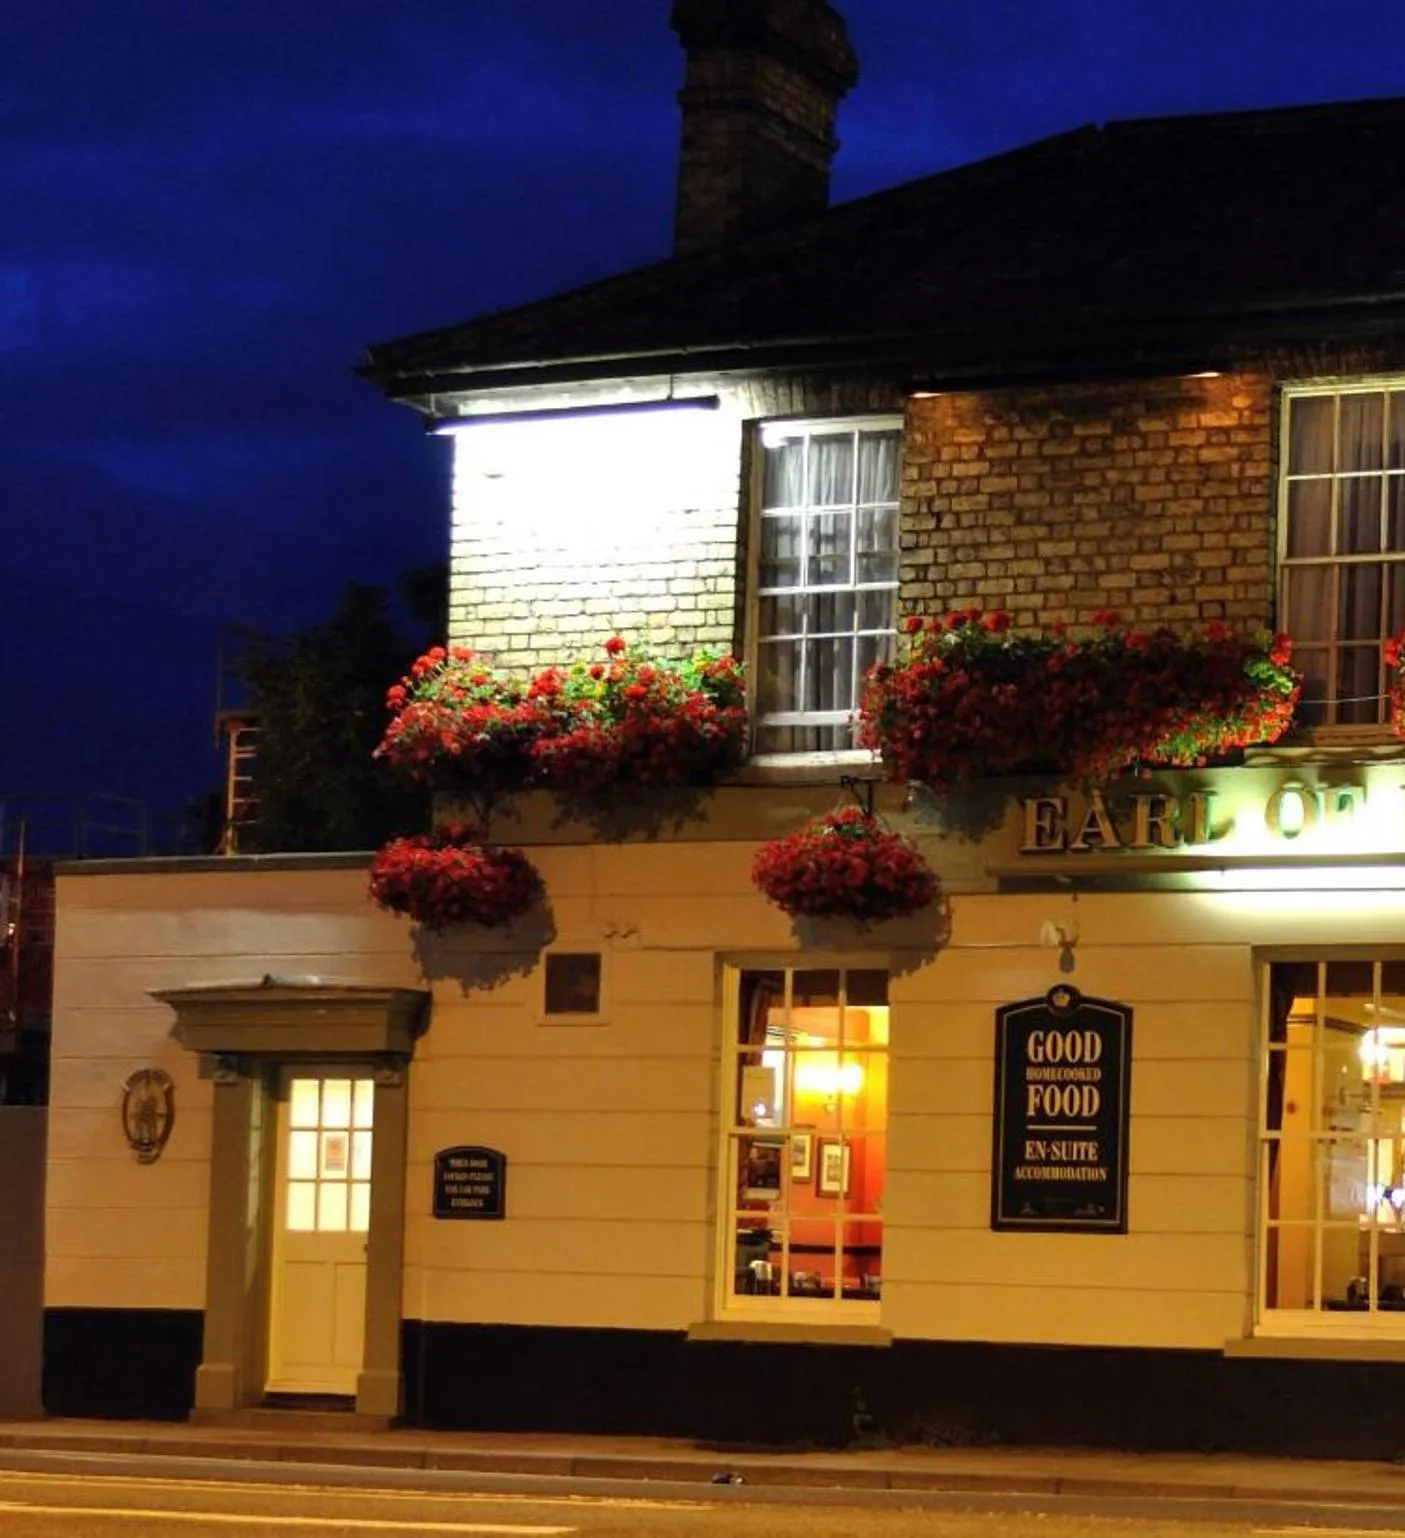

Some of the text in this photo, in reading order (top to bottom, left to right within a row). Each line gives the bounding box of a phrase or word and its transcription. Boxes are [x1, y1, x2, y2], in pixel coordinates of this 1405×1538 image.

[1018, 788, 1236, 853] EARL
[1027, 1030, 1102, 1063] GOOD
[1026, 1067, 1101, 1081] HOMECOOKED
[1026, 1085, 1100, 1117] FOOD
[1015, 1166, 1107, 1180] ACCOMMODATION
